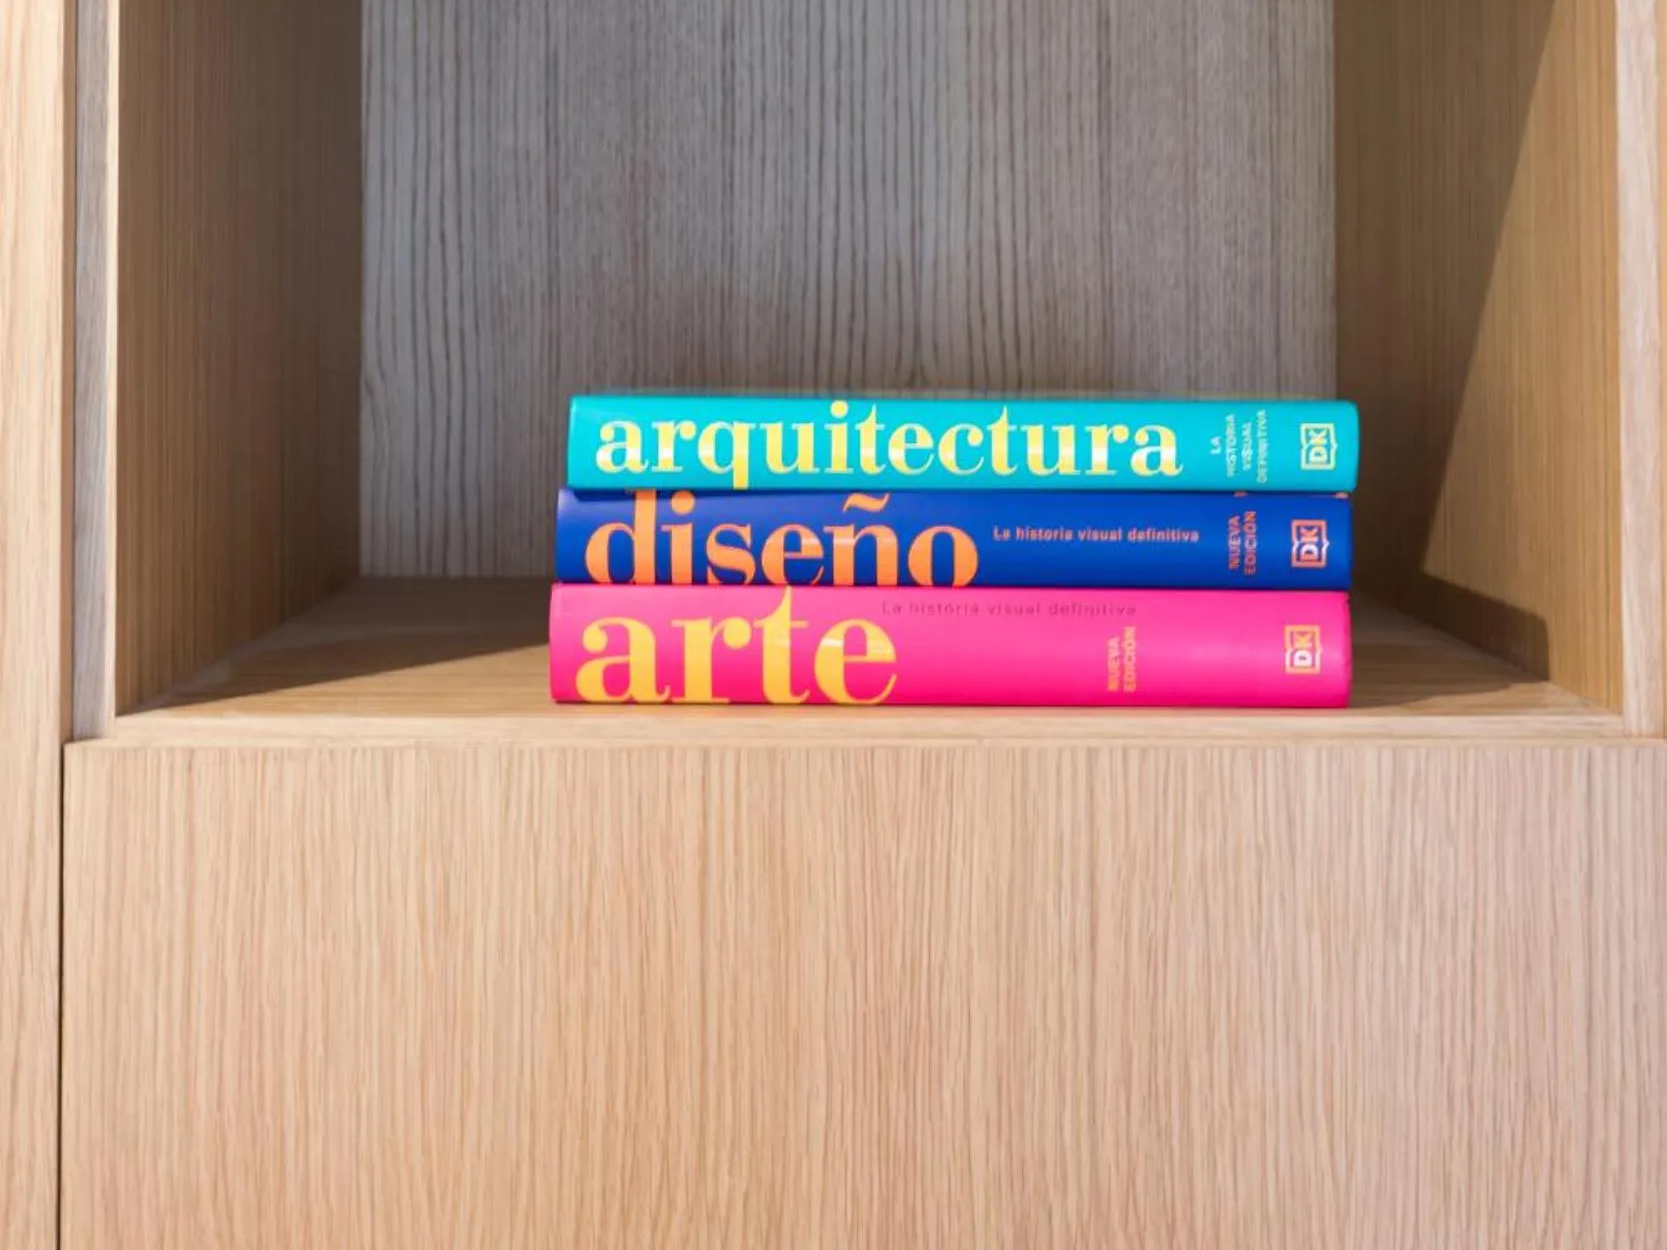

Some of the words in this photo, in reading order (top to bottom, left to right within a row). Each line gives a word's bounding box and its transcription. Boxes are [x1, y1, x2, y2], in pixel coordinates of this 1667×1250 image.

[595, 400, 1184, 489] arquitectura
[1210, 435, 1221, 455] LA
[1309, 429, 1329, 463] DK
[585, 489, 979, 586] diseño
[993, 526, 1010, 541] La
[1016, 526, 1073, 542] historia
[1078, 527, 1123, 542] visual
[1127, 527, 1200, 543] definitiva
[1228, 515, 1241, 570] NUEVA
[1301, 527, 1319, 561] DK
[882, 602, 901, 615] La
[909, 602, 980, 616] historia
[987, 602, 1041, 616] visual
[1048, 603, 1137, 617] definitiva
[575, 586, 898, 704] arte
[1293, 632, 1313, 667] DK
[1107, 636, 1121, 692] NUEVA
